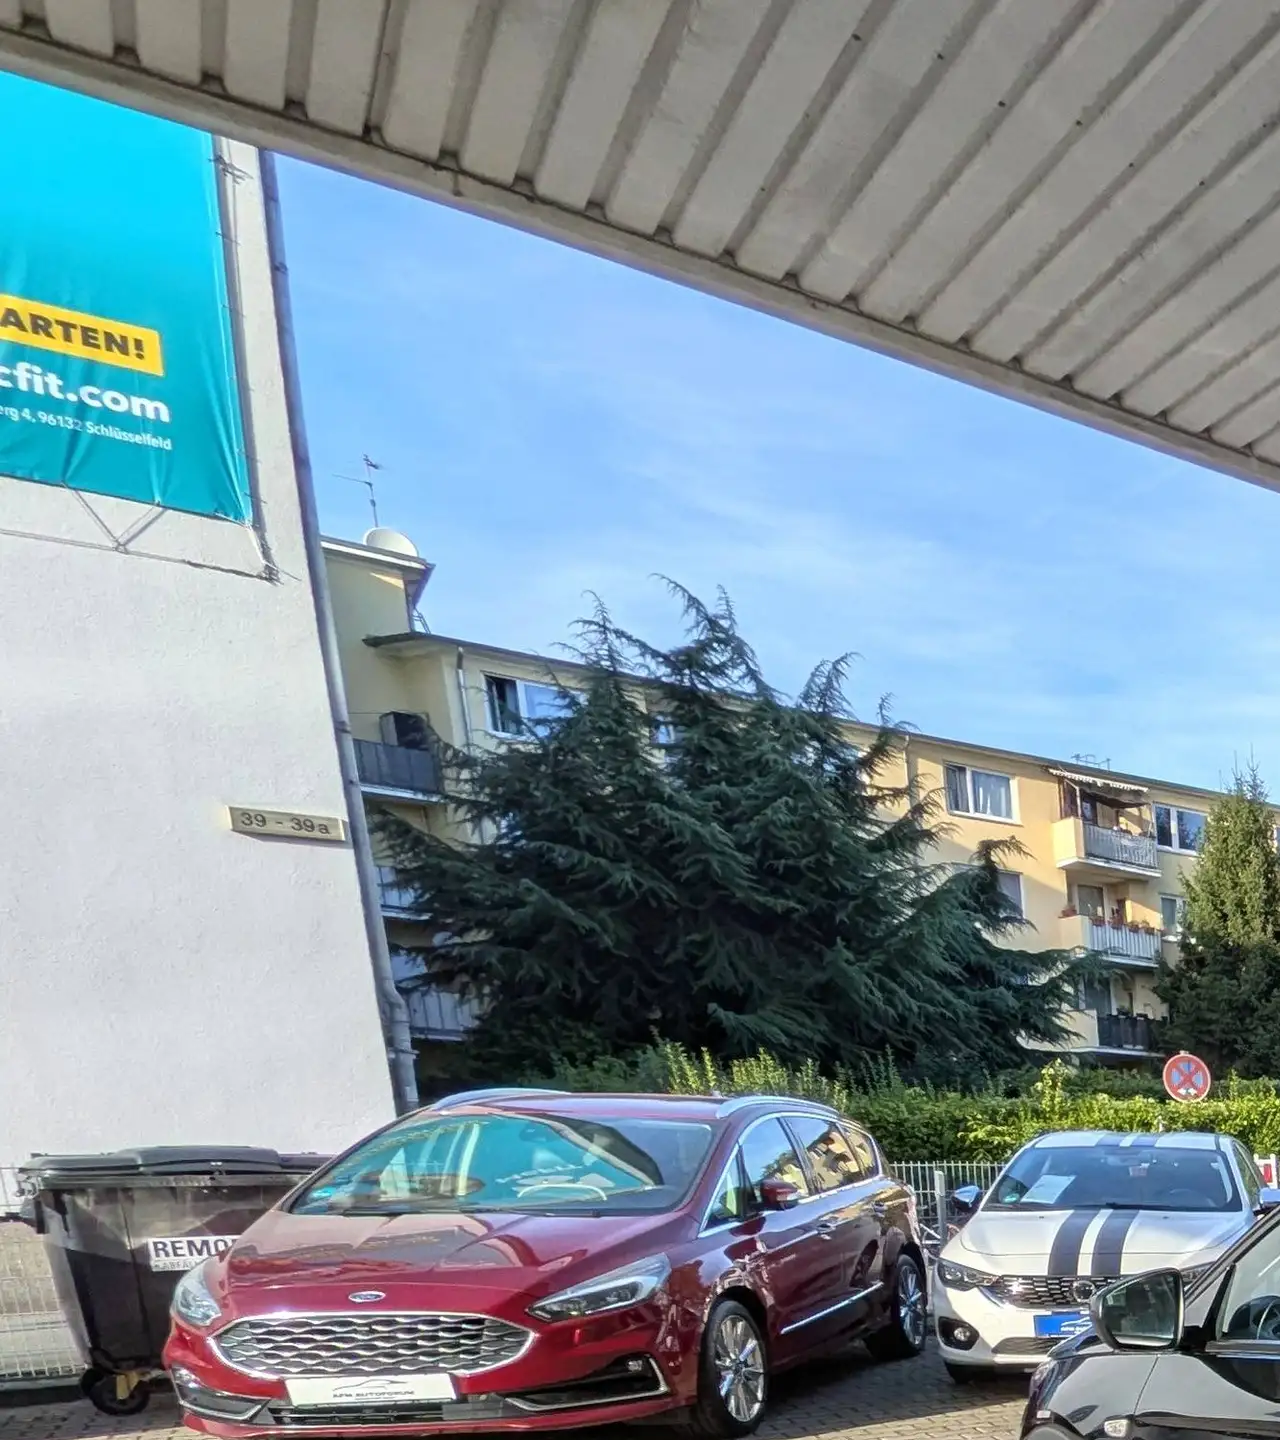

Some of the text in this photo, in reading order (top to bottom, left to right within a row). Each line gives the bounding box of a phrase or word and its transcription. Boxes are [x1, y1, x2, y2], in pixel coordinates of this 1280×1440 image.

[37, 410, 83, 431] 96132
[86, 421, 172, 450] Schlüsselfeld
[241, 812, 267, 828] 39
[152, 1238, 237, 1258] REMO
